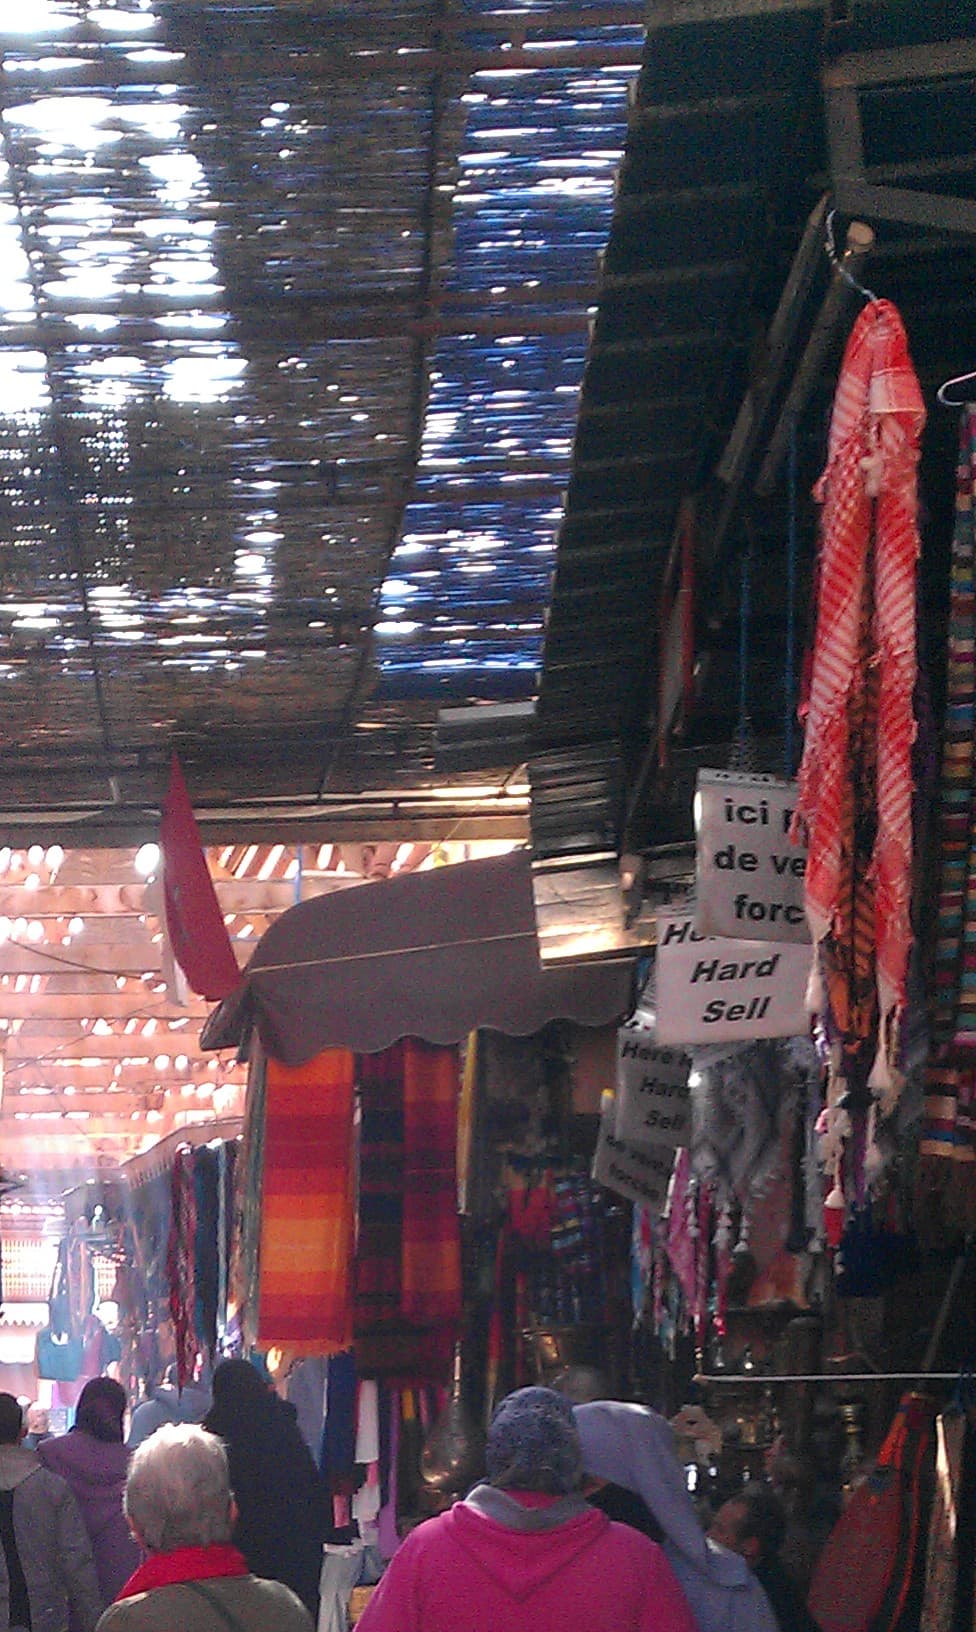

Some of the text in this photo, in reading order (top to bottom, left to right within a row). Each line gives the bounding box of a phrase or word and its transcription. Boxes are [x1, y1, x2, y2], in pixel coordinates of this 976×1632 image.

[724, 797, 769, 825] ici
[714, 844, 807, 877] de ve
[734, 893, 806, 924] forc
[690, 953, 782, 983] Hard
[702, 996, 772, 1024] Sell
